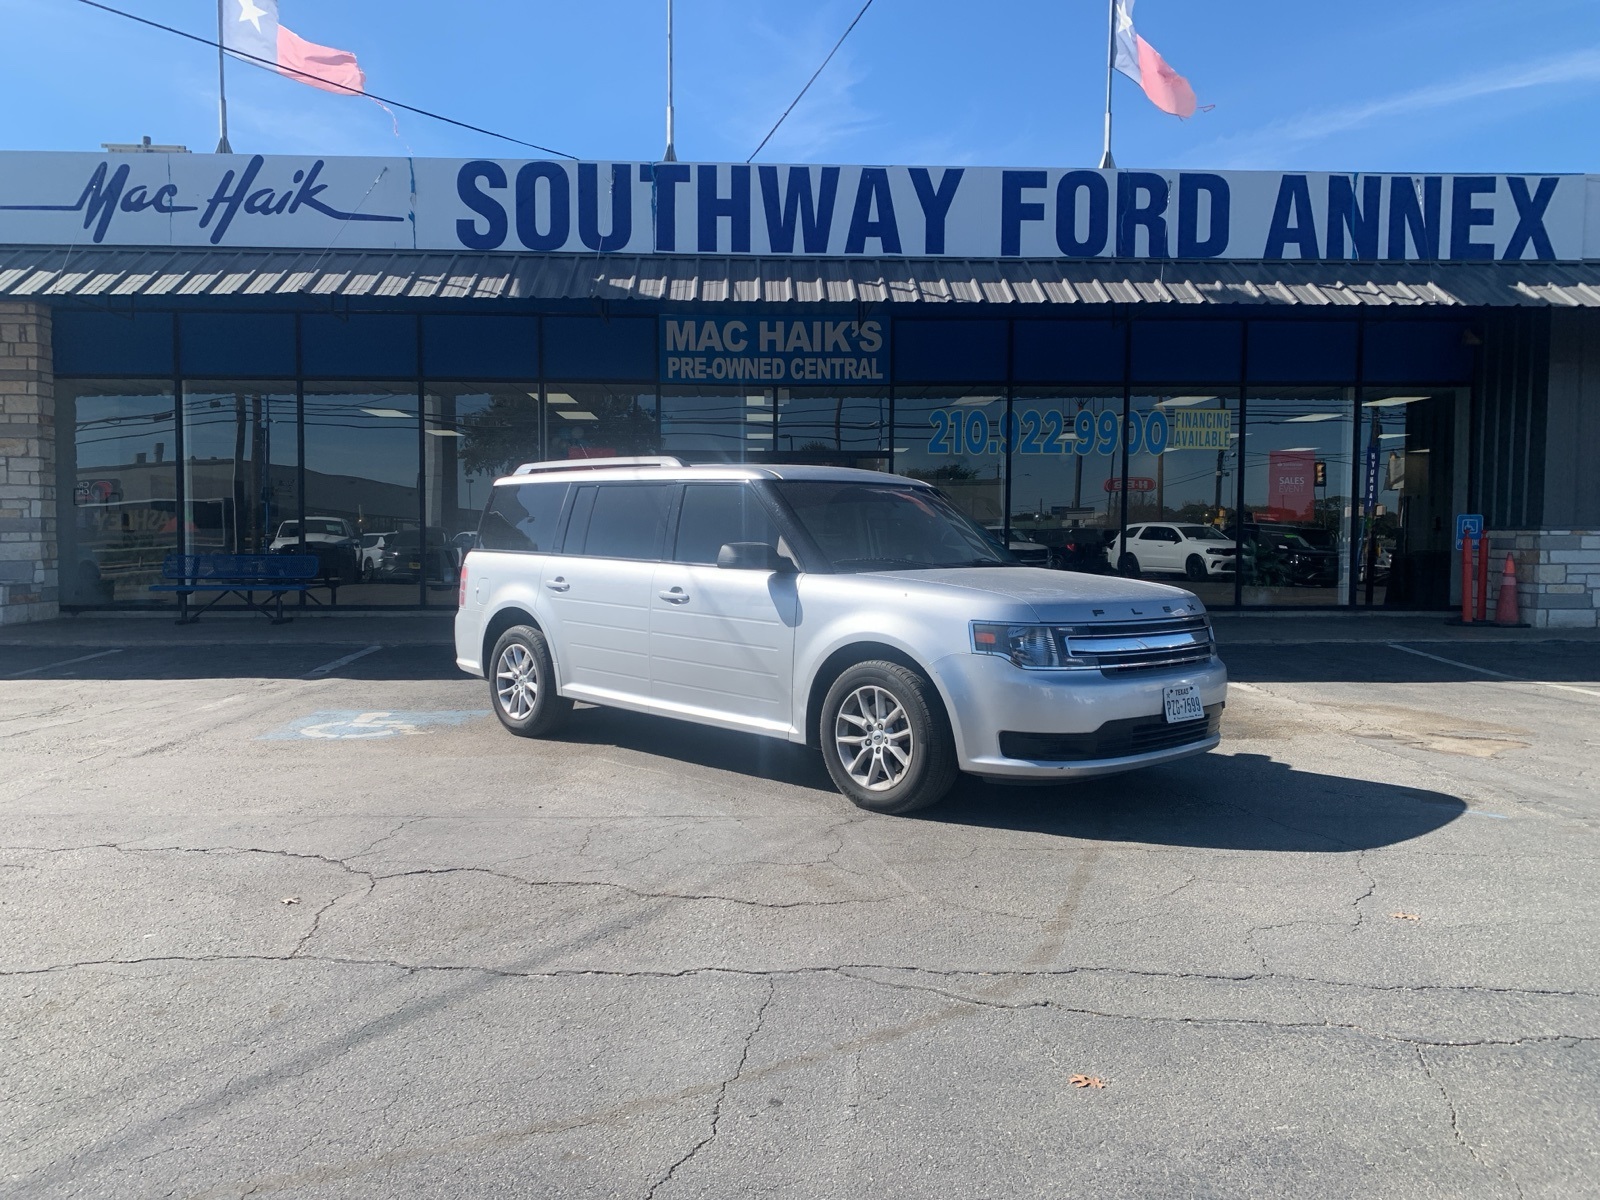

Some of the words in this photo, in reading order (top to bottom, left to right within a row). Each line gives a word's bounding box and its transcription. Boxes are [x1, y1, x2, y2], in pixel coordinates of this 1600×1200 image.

[76, 161, 198, 244] Mac
[199, 154, 335, 245] Haik
[456, 160, 966, 256] SOUTHWAY
[1000, 169, 1231, 259] FORD
[1263, 174, 1560, 262] ANNEX
[665, 320, 749, 352] MAC
[759, 320, 883, 353] HAIK'S
[667, 357, 786, 380] PRE-OWNED
[790, 357, 884, 380] CENTRAL
[1174, 411, 1231, 429] FINANCING
[928, 409, 1169, 457] 210.922.9900
[1174, 429, 1231, 448] AVAILABLE
[1278, 476, 1305, 485] SALES
[1278, 485, 1305, 493] EVENT
[1091, 603, 1197, 617] FLEX
[1174, 687, 1190, 696] TEXAS
